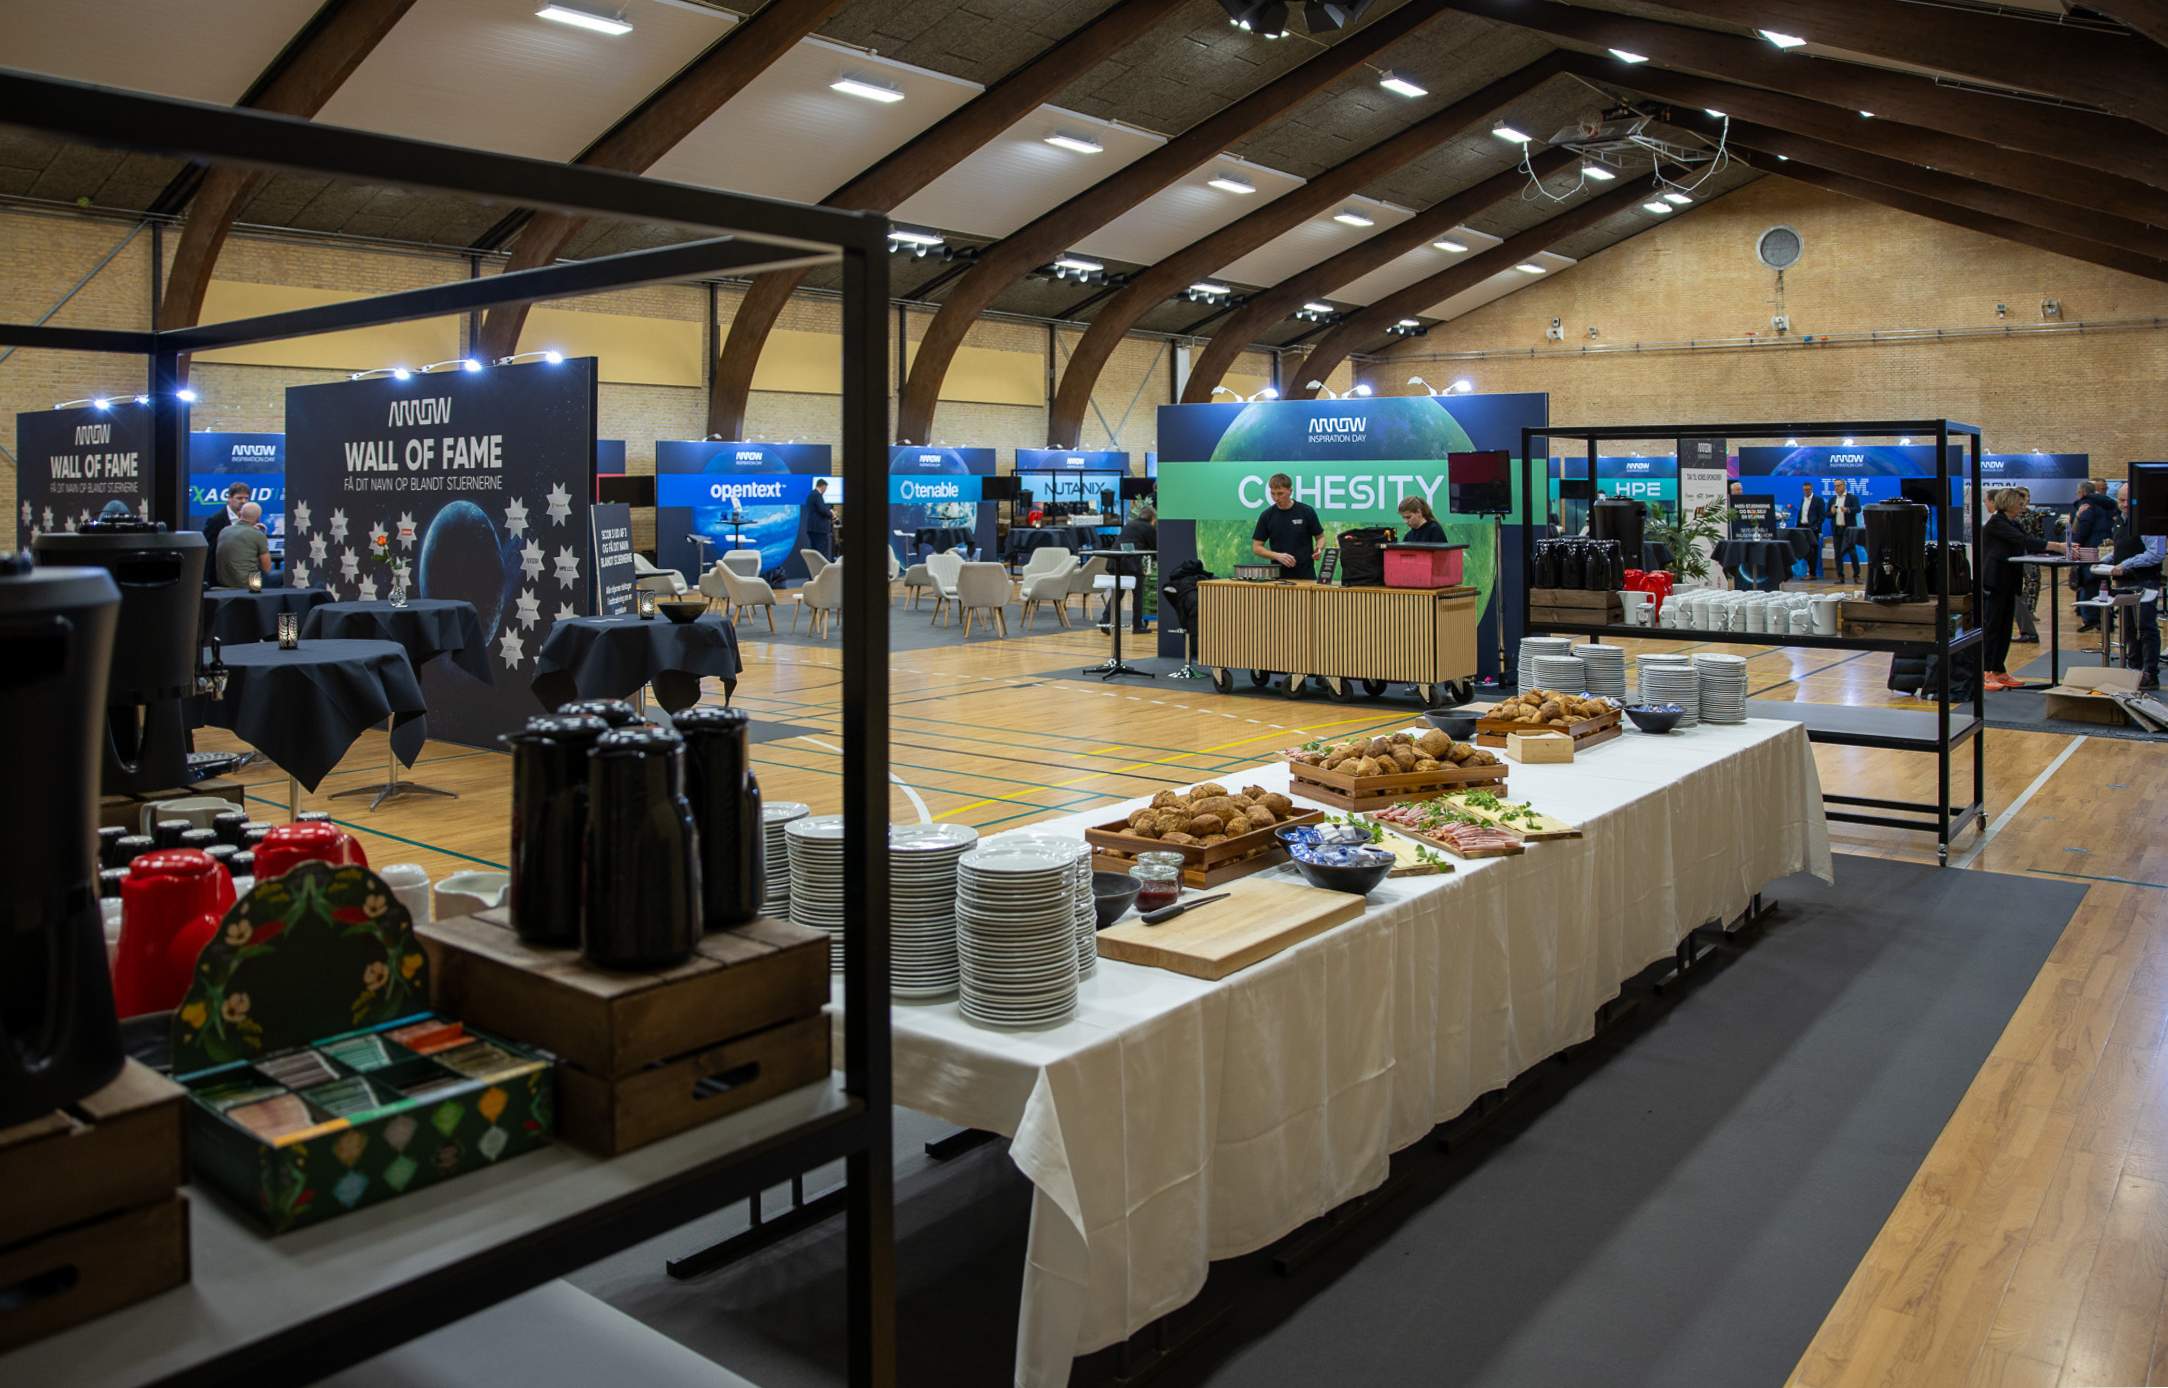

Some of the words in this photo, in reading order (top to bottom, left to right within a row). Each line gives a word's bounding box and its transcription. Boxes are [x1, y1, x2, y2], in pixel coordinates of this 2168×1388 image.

[388, 397, 452, 427] ARROW
[1309, 417, 1366, 432] ARROW
[75, 424, 111, 446] ARROW
[1309, 434, 1350, 443] INSPIRATION
[1352, 434, 1366, 443] DAY
[232, 445, 276, 456] ARROW
[345, 440, 399, 471] WALL
[405, 438, 434, 471] OF
[443, 435, 503, 470] FAME
[1830, 454, 1864, 463] ARROW
[50, 455, 82, 479] WALL
[84, 454, 101, 478] OF
[105, 452, 138, 478] FAME
[344, 475, 354, 491] FÅ
[356, 477, 368, 491] DIT
[371, 477, 393, 491] NAVN
[395, 477, 408, 491] OP
[411, 476, 444, 491] BLANDT
[447, 475, 503, 490] STJERNERNE
[710, 481, 782, 501] opentext
[914, 481, 959, 498] tenable
[1044, 481, 1105, 496] NUTANIX
[1615, 481, 1661, 497] HPE
[1821, 478, 1869, 496] IM
